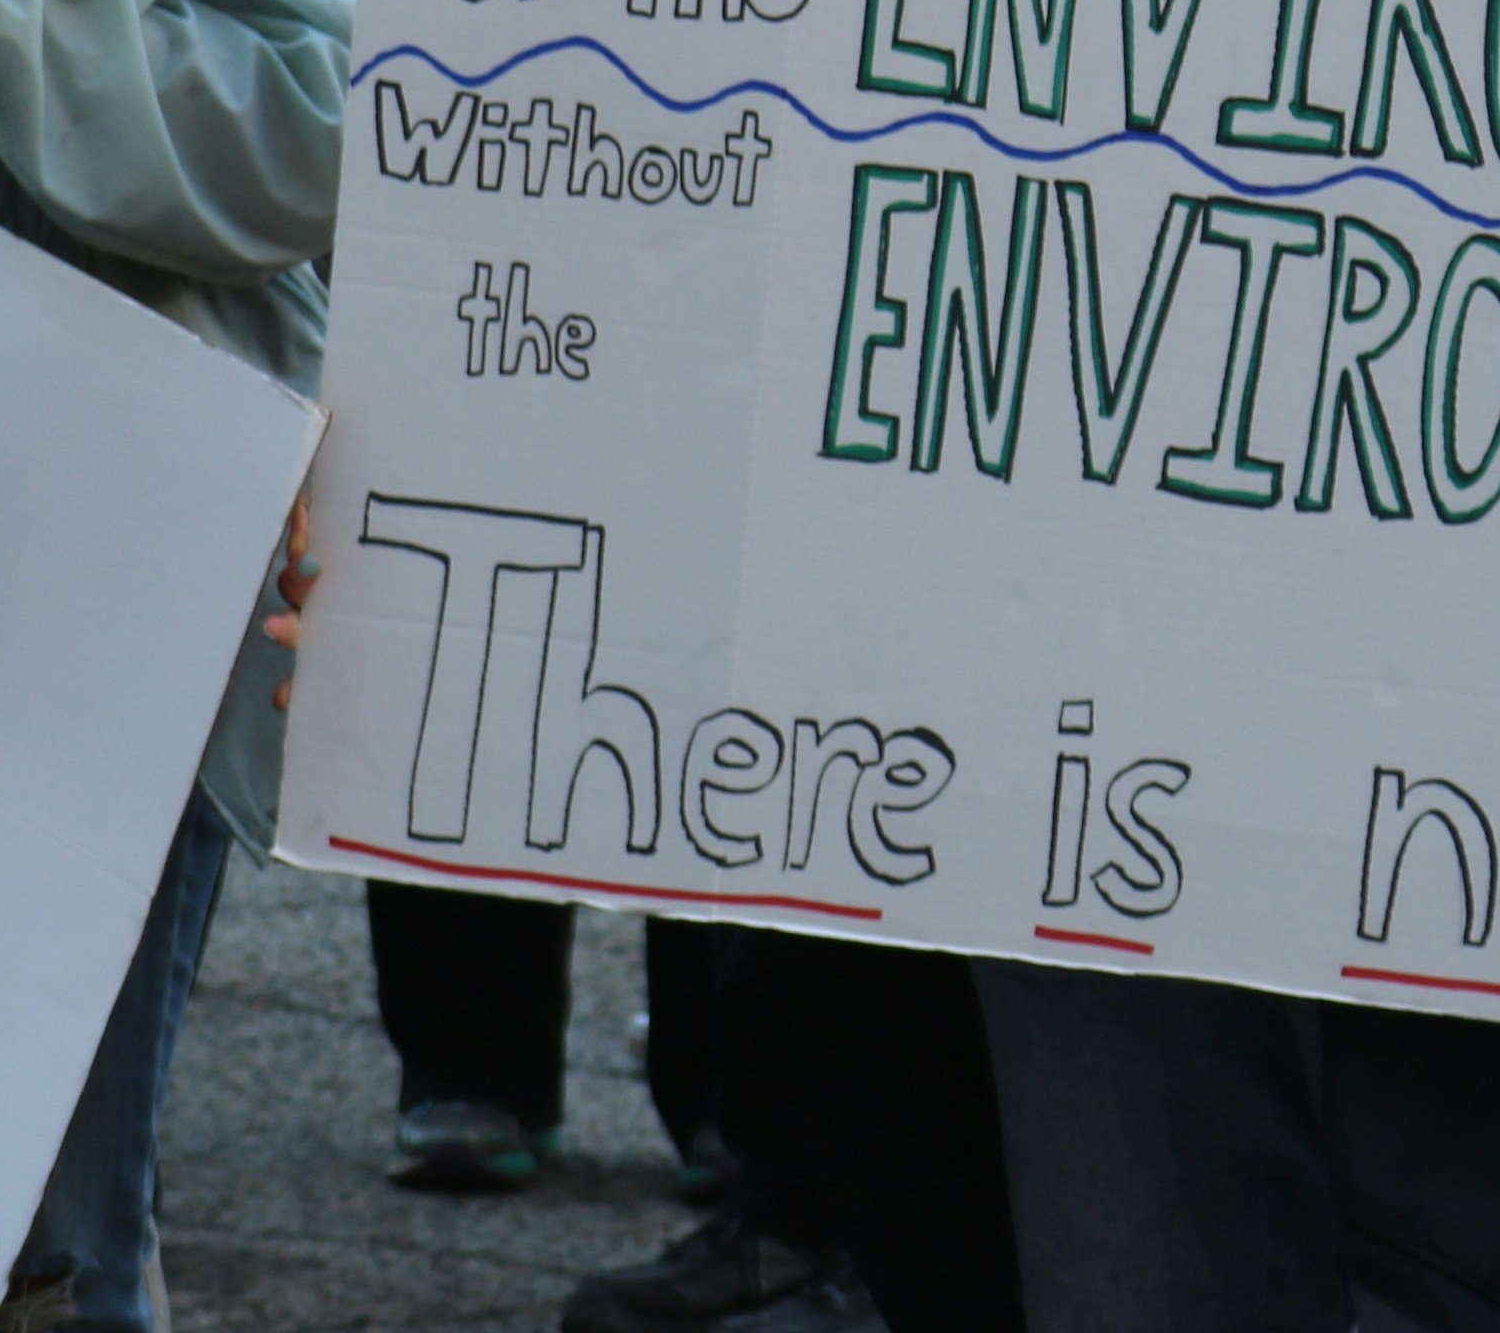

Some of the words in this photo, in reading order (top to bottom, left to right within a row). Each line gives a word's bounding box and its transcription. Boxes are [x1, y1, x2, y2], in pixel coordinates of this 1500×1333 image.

[457, 260, 596, 384] the
[359, 492, 956, 885] There
[1040, 700, 1191, 918] is
